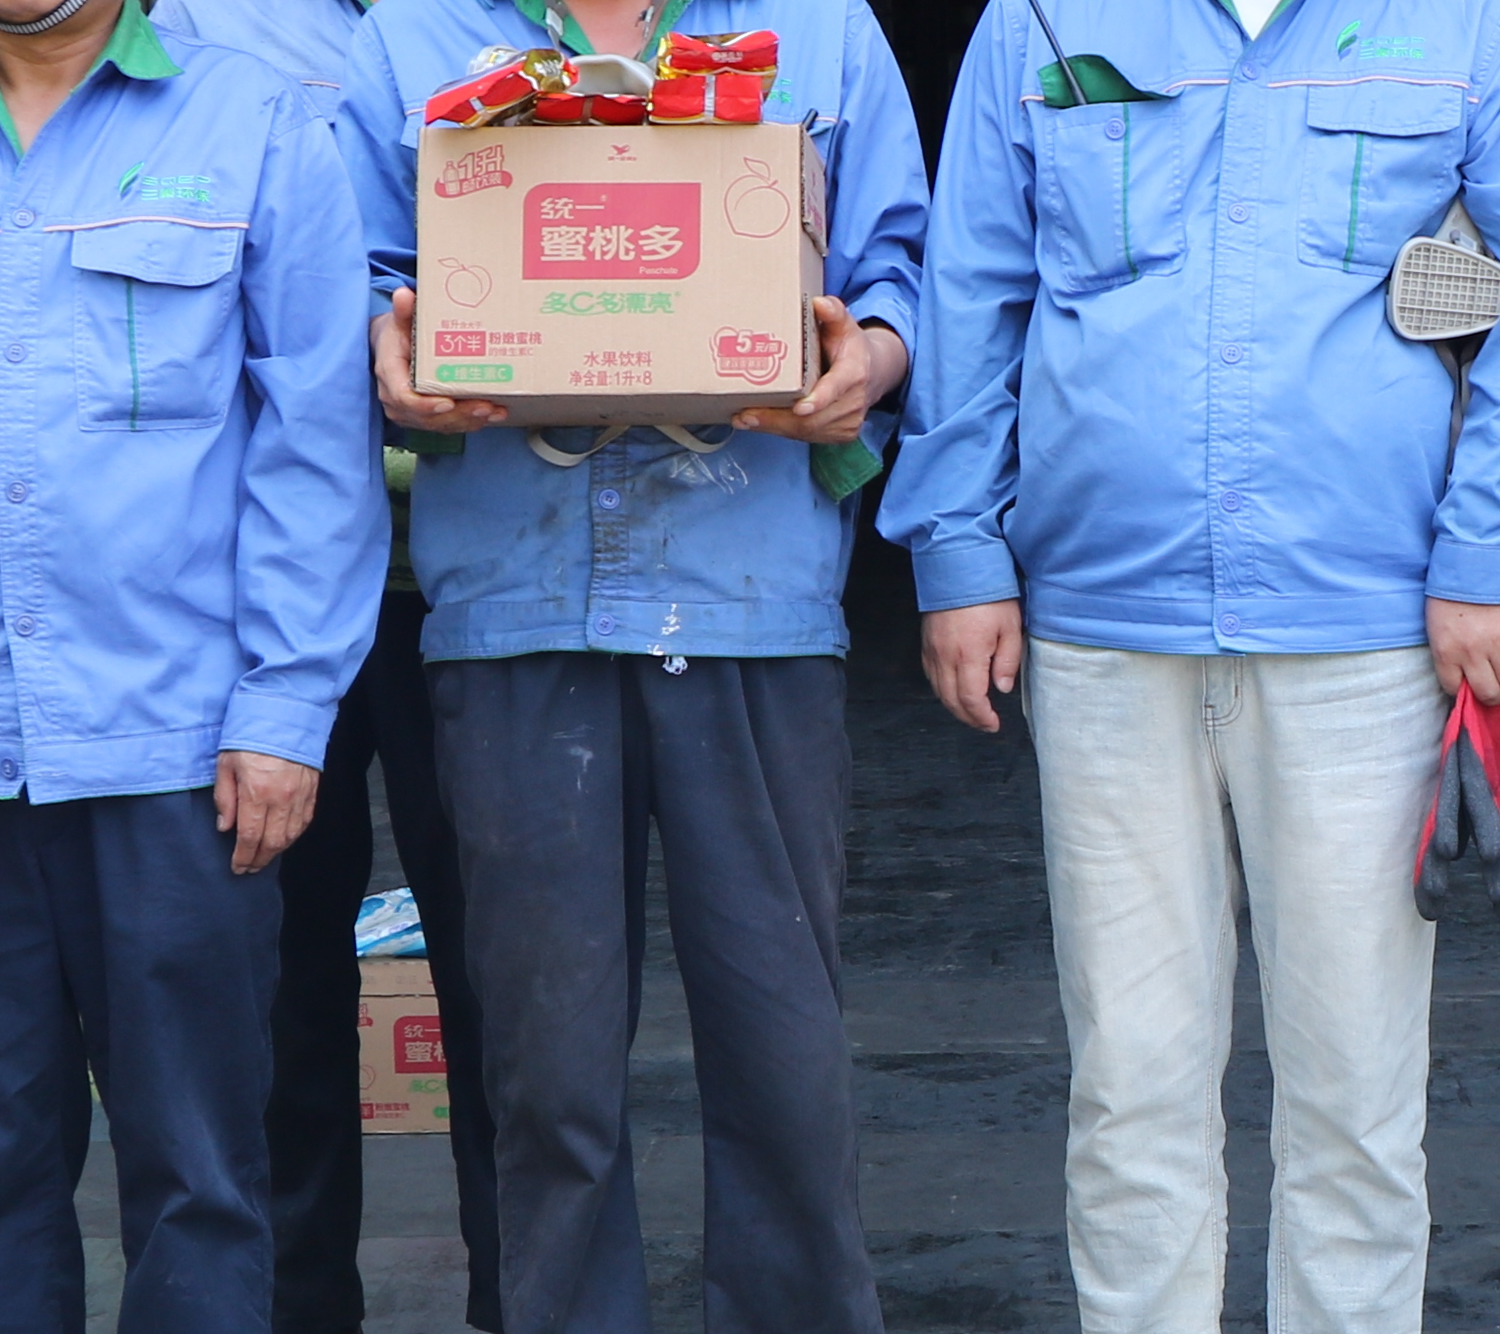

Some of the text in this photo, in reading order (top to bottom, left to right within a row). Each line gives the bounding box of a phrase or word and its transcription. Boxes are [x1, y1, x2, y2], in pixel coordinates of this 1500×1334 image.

[540, 198, 605, 219] 统一
[540, 225, 683, 261] 蜜桃多
[539, 291, 675, 315] 多C多漂亮
[440, 334, 481, 353] 3个半
[488, 331, 542, 345] 粉嫩蜜桃
[583, 352, 652, 367] 水果饮料
